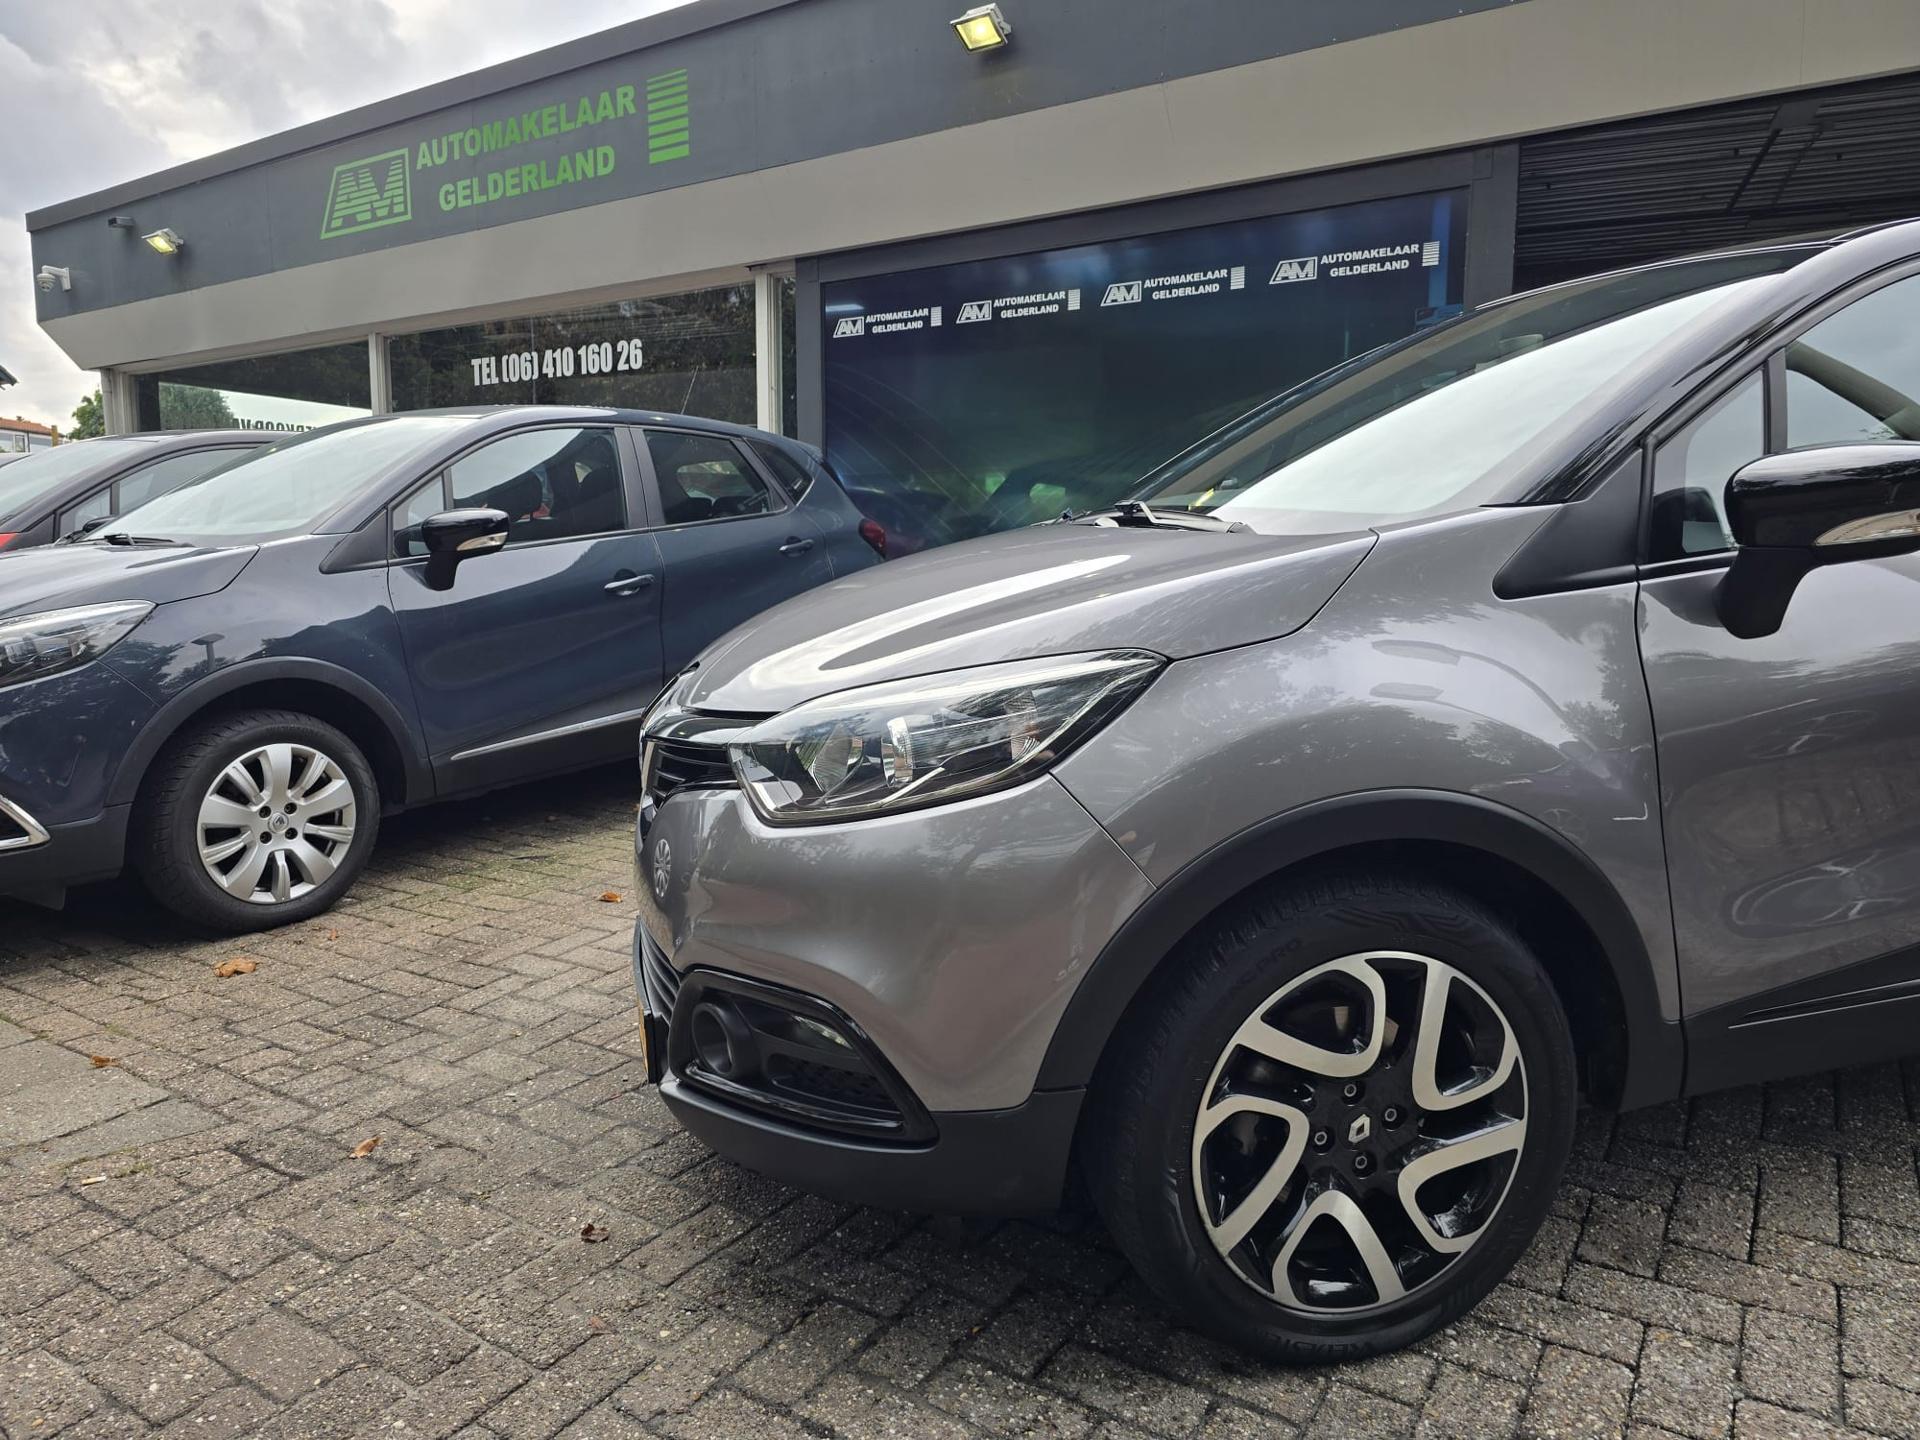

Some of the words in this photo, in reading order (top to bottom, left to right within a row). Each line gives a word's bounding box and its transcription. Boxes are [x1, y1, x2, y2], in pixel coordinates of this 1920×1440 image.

[416, 84, 637, 170] AUTOMAKELAAR
[438, 145, 616, 212] GELDERLAND
[1320, 243, 1420, 264] AUTOMAKELAAR
[1329, 259, 1410, 277] GELDERLAND
[1144, 268, 1228, 289] AUTOMAKELAAR
[993, 290, 1066, 308] AUTOMAKELAAR
[1152, 283, 1220, 300] GELDERLAND
[865, 307, 929, 323] AUTOMAKELAAR
[1000, 303, 1059, 319] GELDERLAND
[872, 320, 923, 334] GELDERLAND
[471, 356, 499, 386] TEL
[501, 351, 539, 383] (06)
[542, 346, 574, 378] 410
[577, 342, 613, 375] 160
[617, 338, 643, 371] 26
